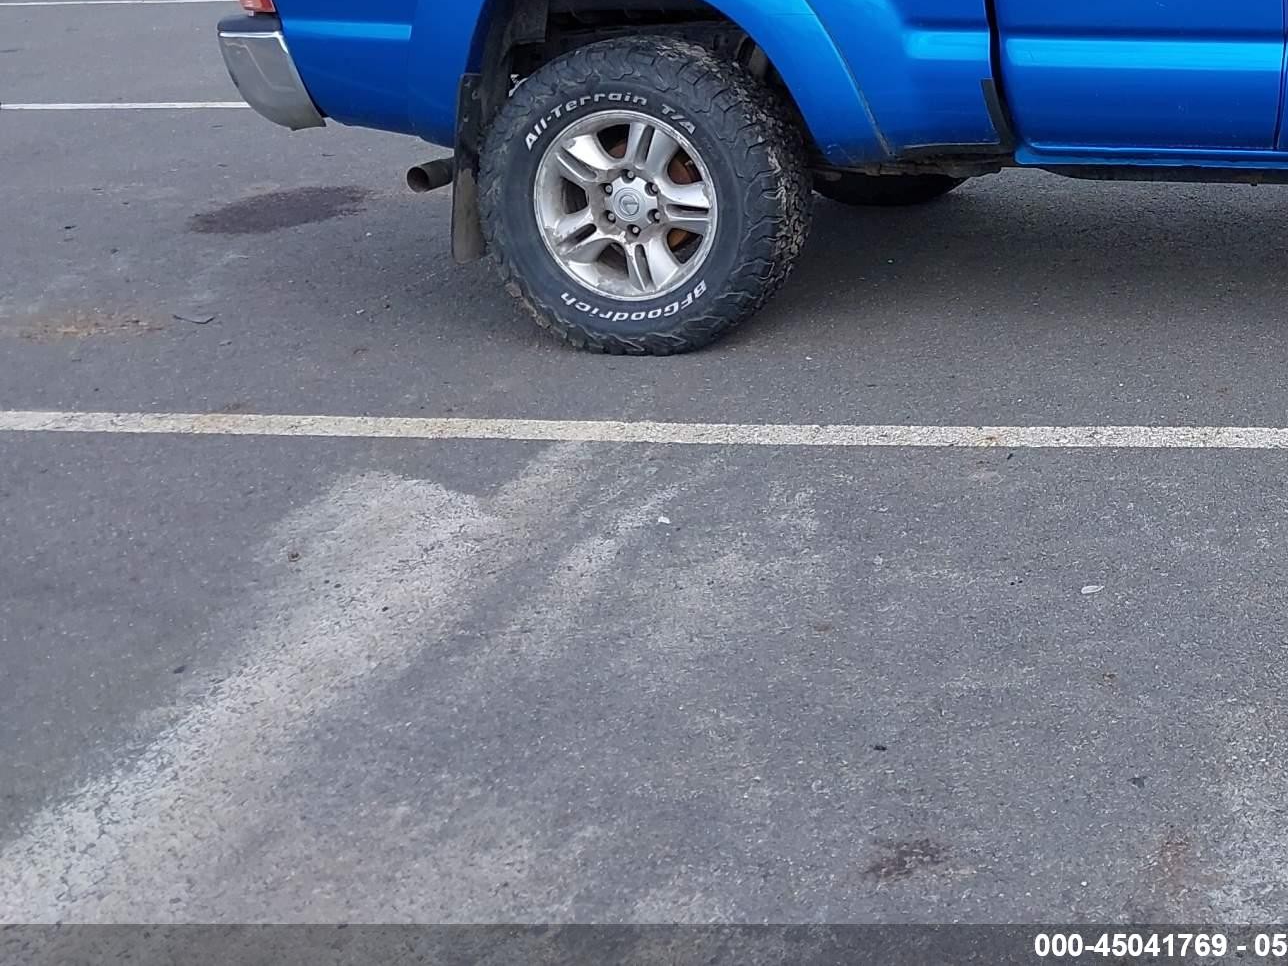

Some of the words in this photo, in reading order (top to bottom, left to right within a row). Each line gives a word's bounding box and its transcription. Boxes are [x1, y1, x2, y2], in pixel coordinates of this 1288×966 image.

[524, 91, 648, 152] All-Terrain
[661, 103, 697, 135] T/A
[560, 279, 707, 322] BFGoodrich
